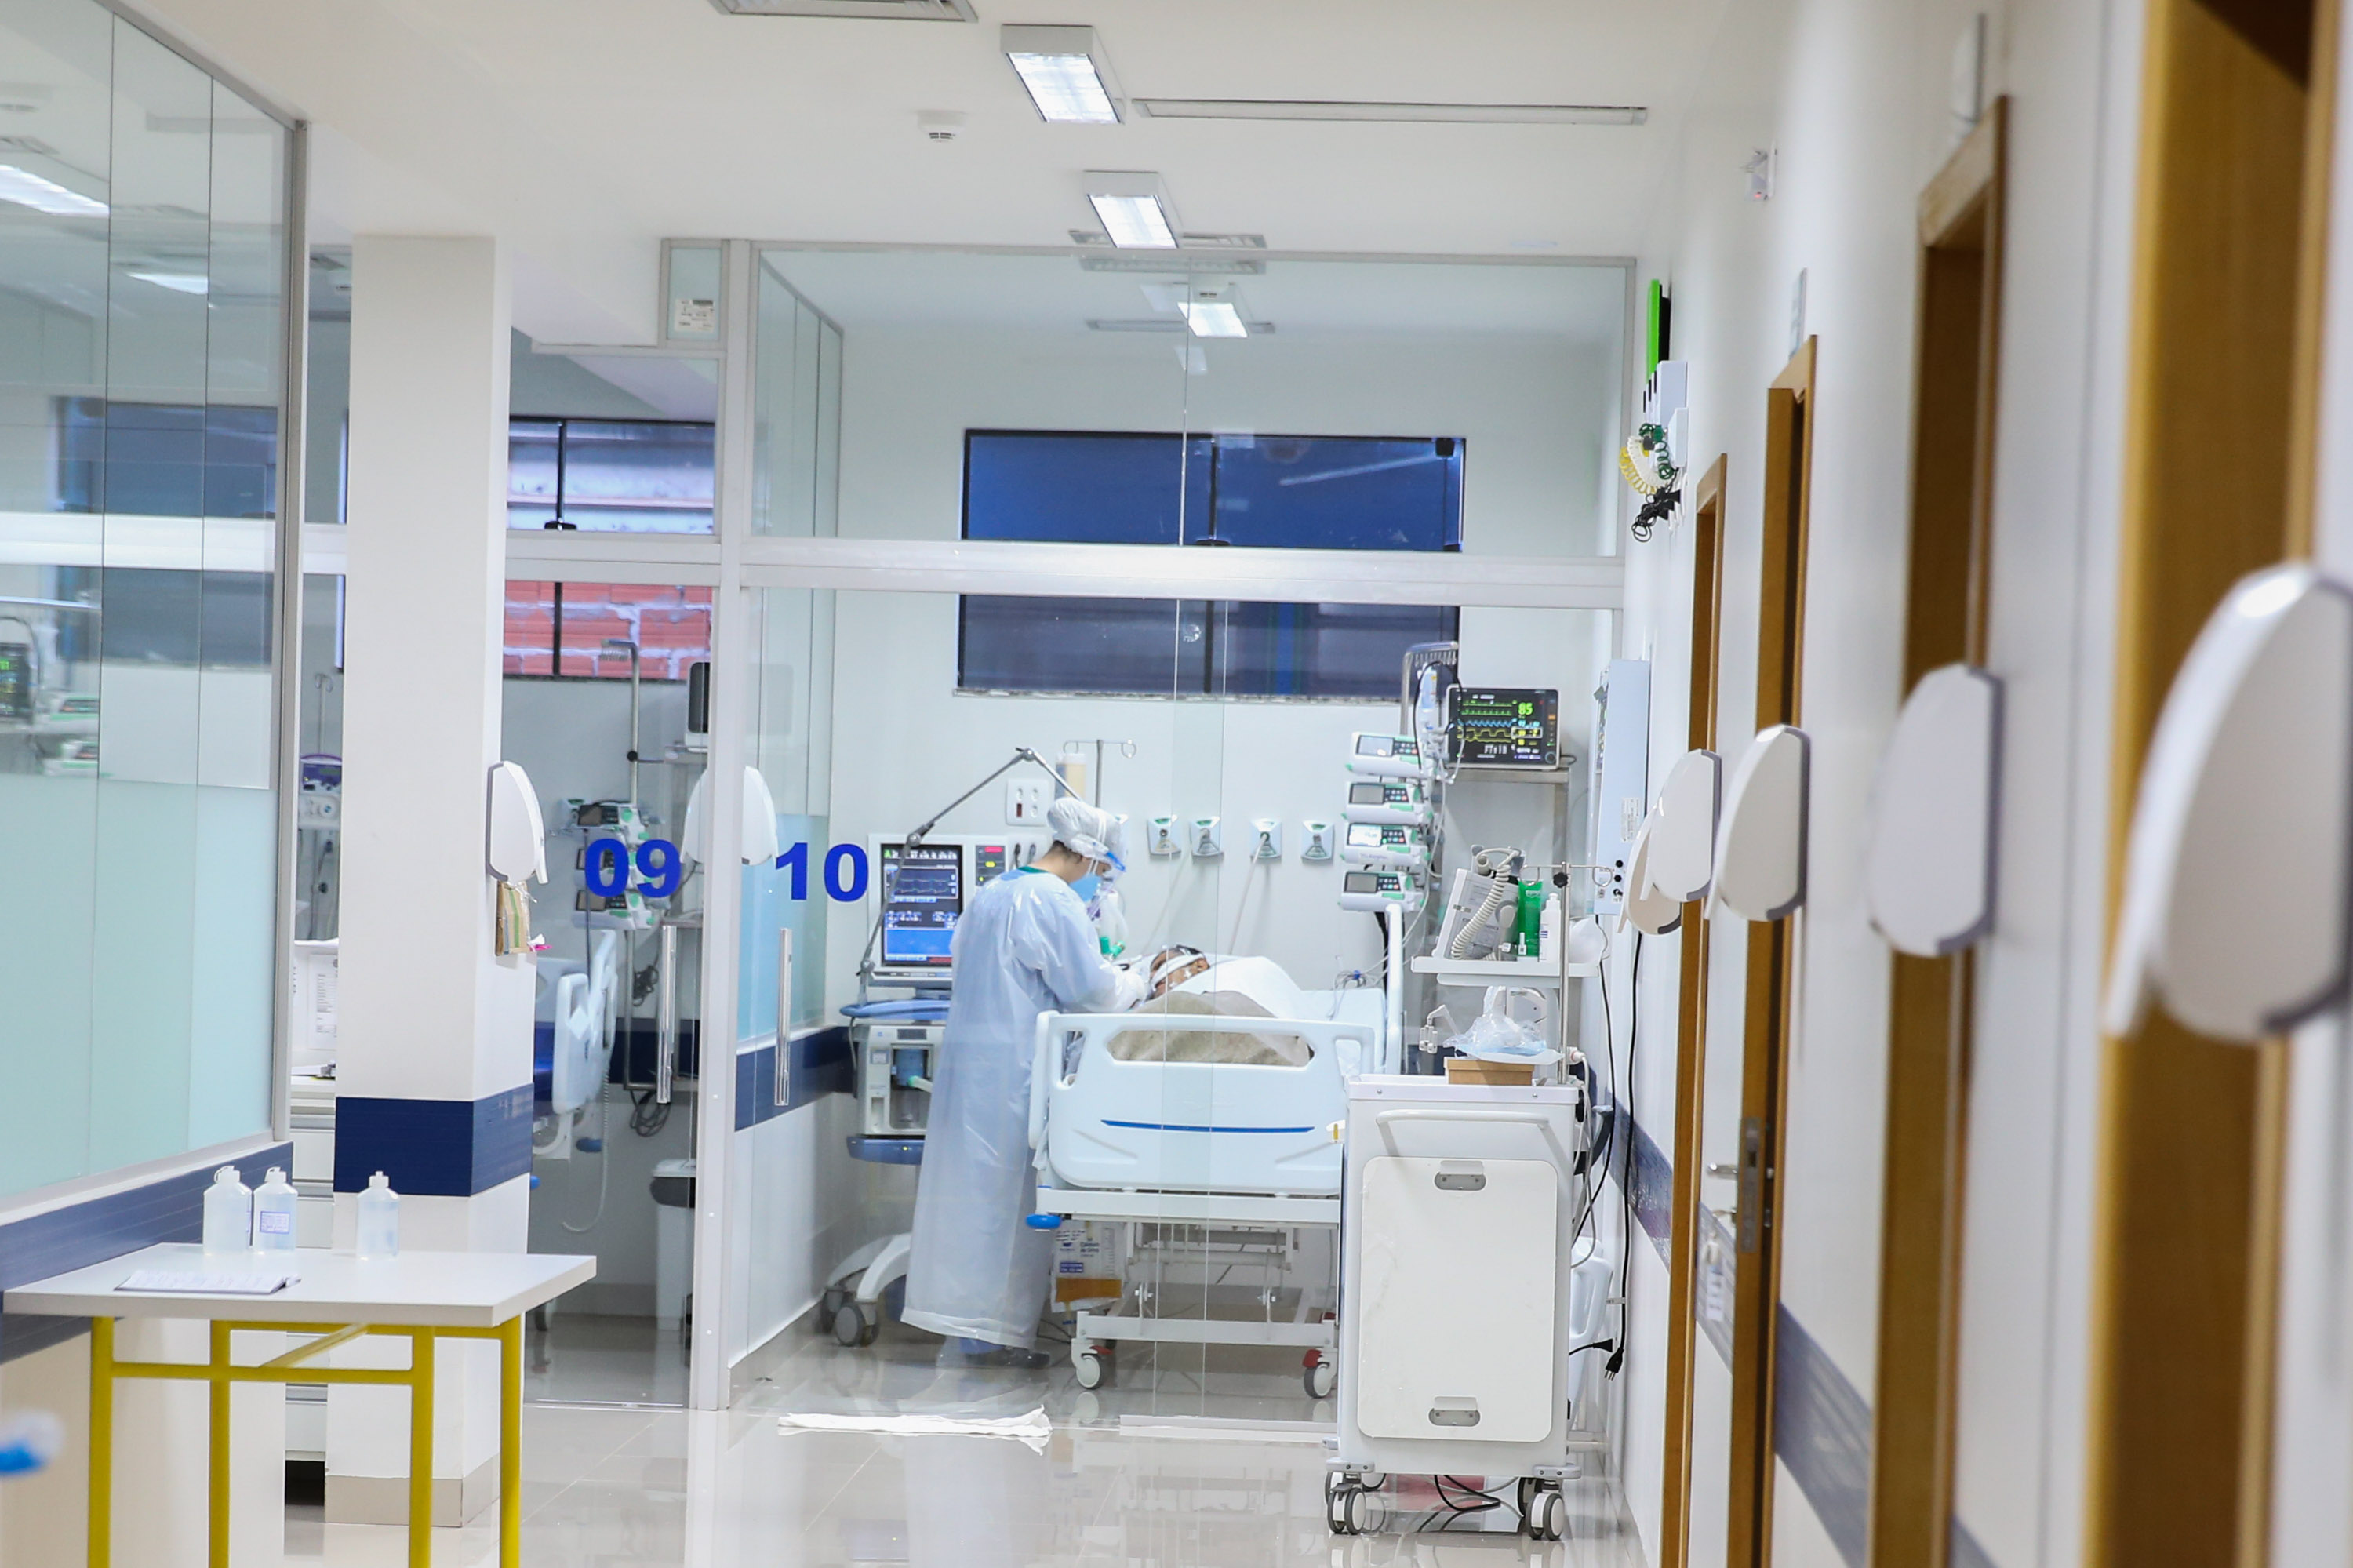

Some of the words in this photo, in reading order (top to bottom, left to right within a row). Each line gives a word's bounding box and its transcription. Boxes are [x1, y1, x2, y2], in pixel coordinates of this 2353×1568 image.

[1518, 702, 1533, 715] 85
[584, 838, 682, 898] 09
[775, 842, 868, 902] 10
